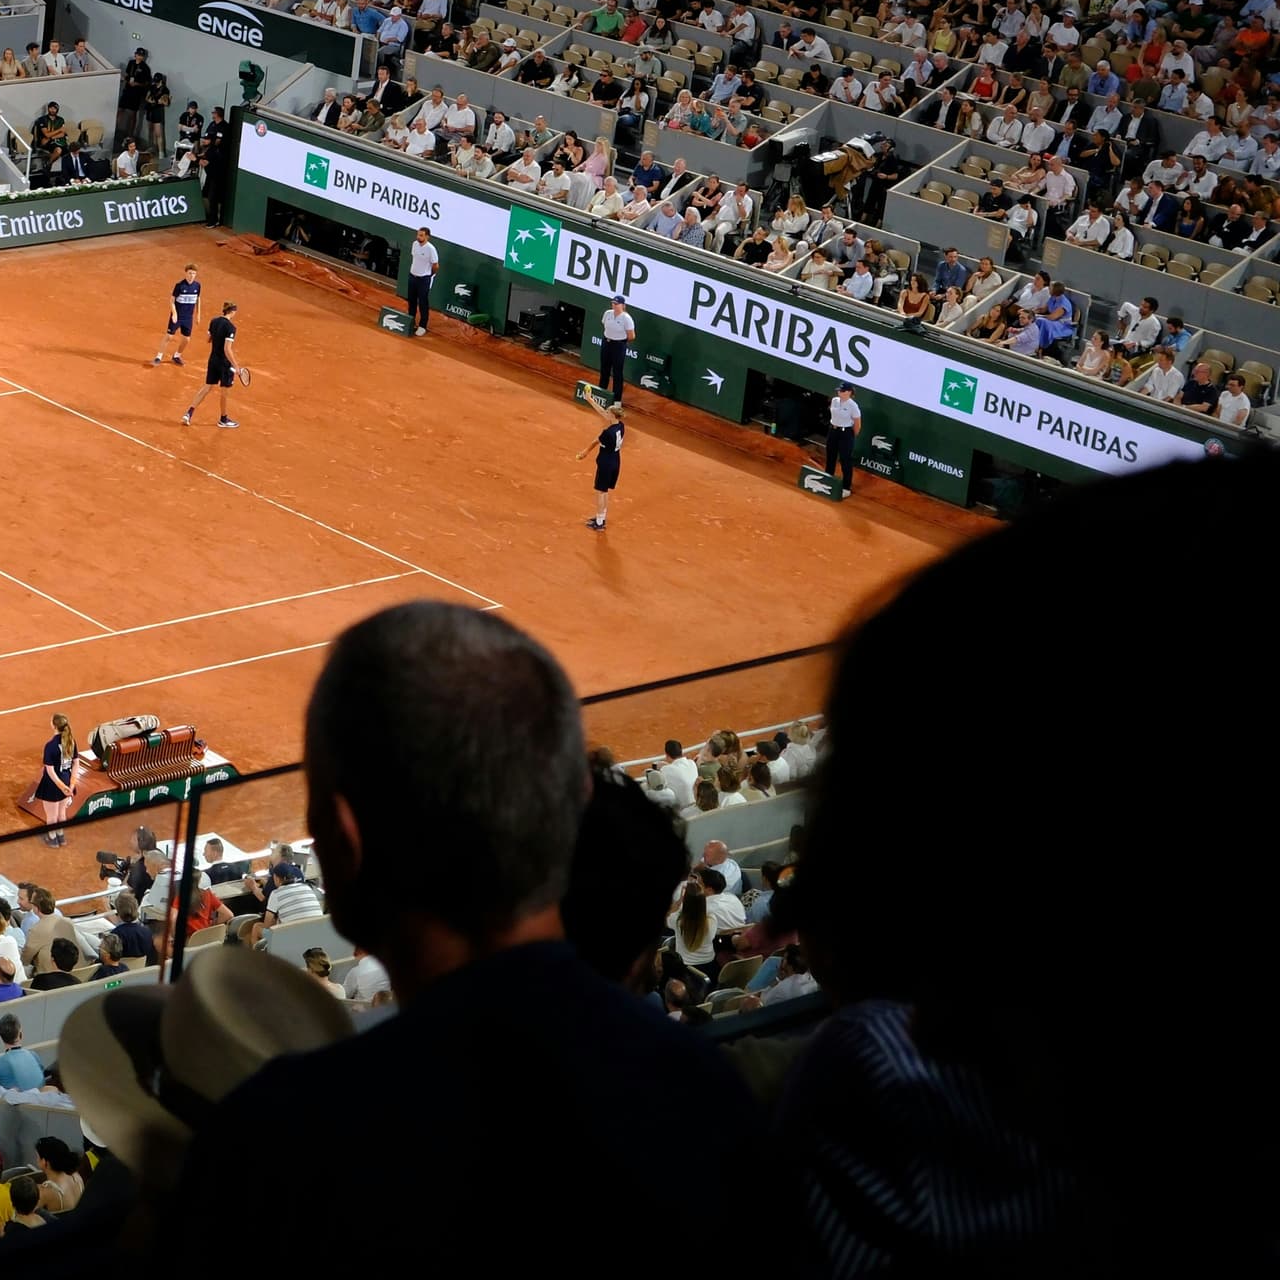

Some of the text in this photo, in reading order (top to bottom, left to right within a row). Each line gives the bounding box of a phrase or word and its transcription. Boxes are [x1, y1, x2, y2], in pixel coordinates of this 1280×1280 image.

[103, 192, 188, 224] Emirates
[333, 168, 441, 221] BNP PARIBAS
[566, 239, 871, 378] BNP PARIBAS
[983, 391, 1138, 463] BNP PARIBAS
[860, 457, 893, 476] LACOSTE
[908, 451, 964, 478] BNP PARIBAS
